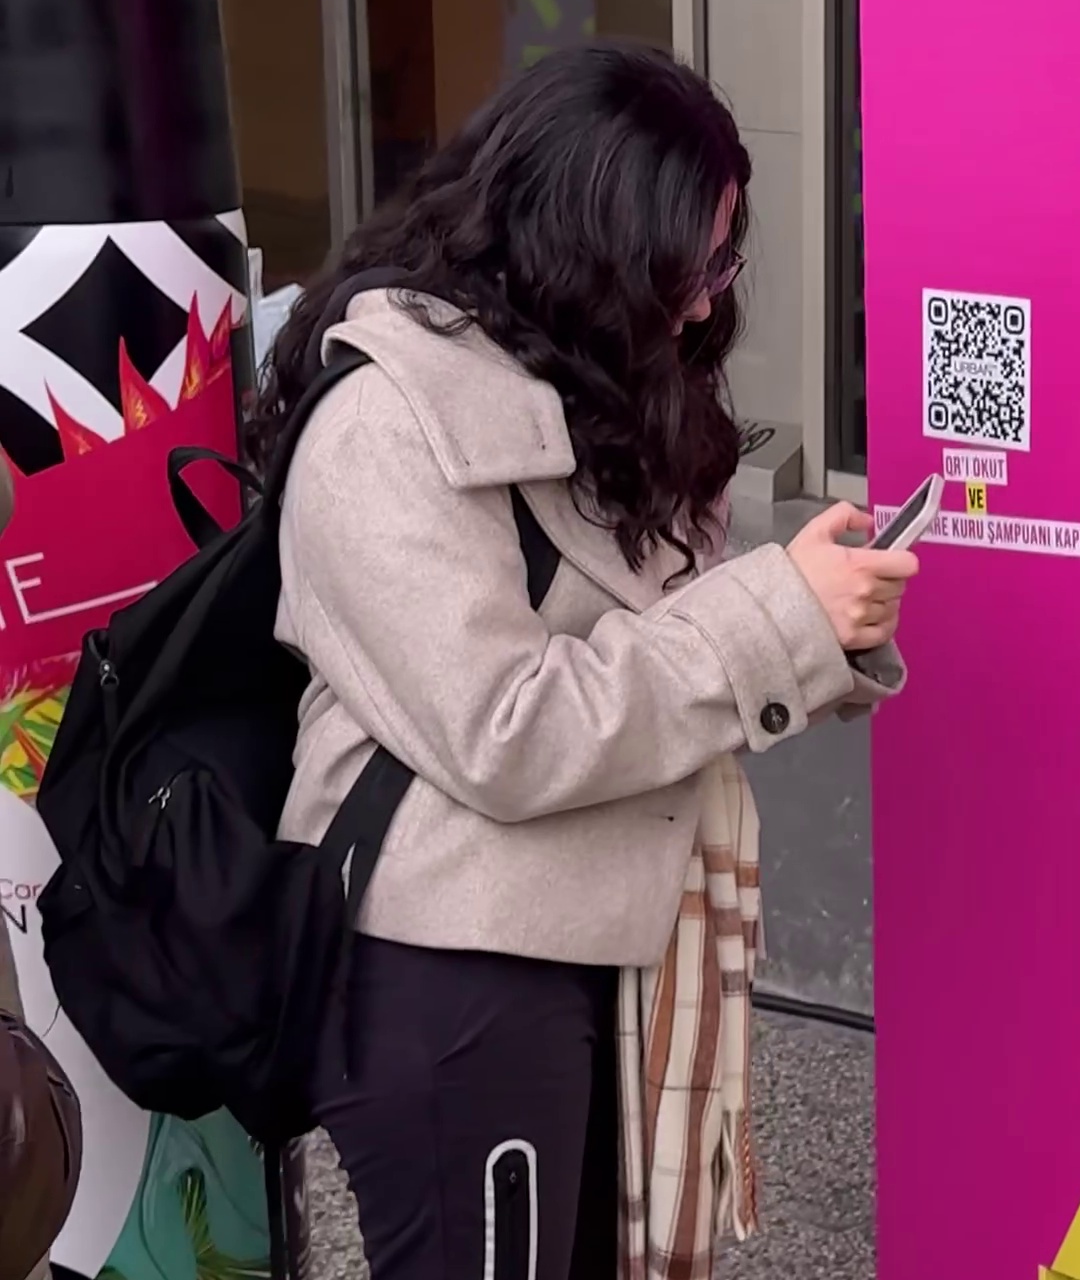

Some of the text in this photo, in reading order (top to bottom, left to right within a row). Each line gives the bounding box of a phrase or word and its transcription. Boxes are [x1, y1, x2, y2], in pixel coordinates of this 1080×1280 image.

[973, 457, 1005, 479] OKUT
[968, 487, 984, 510] VE
[952, 518, 985, 541] KURU
[987, 520, 1051, 547] ŞAMPUANI
